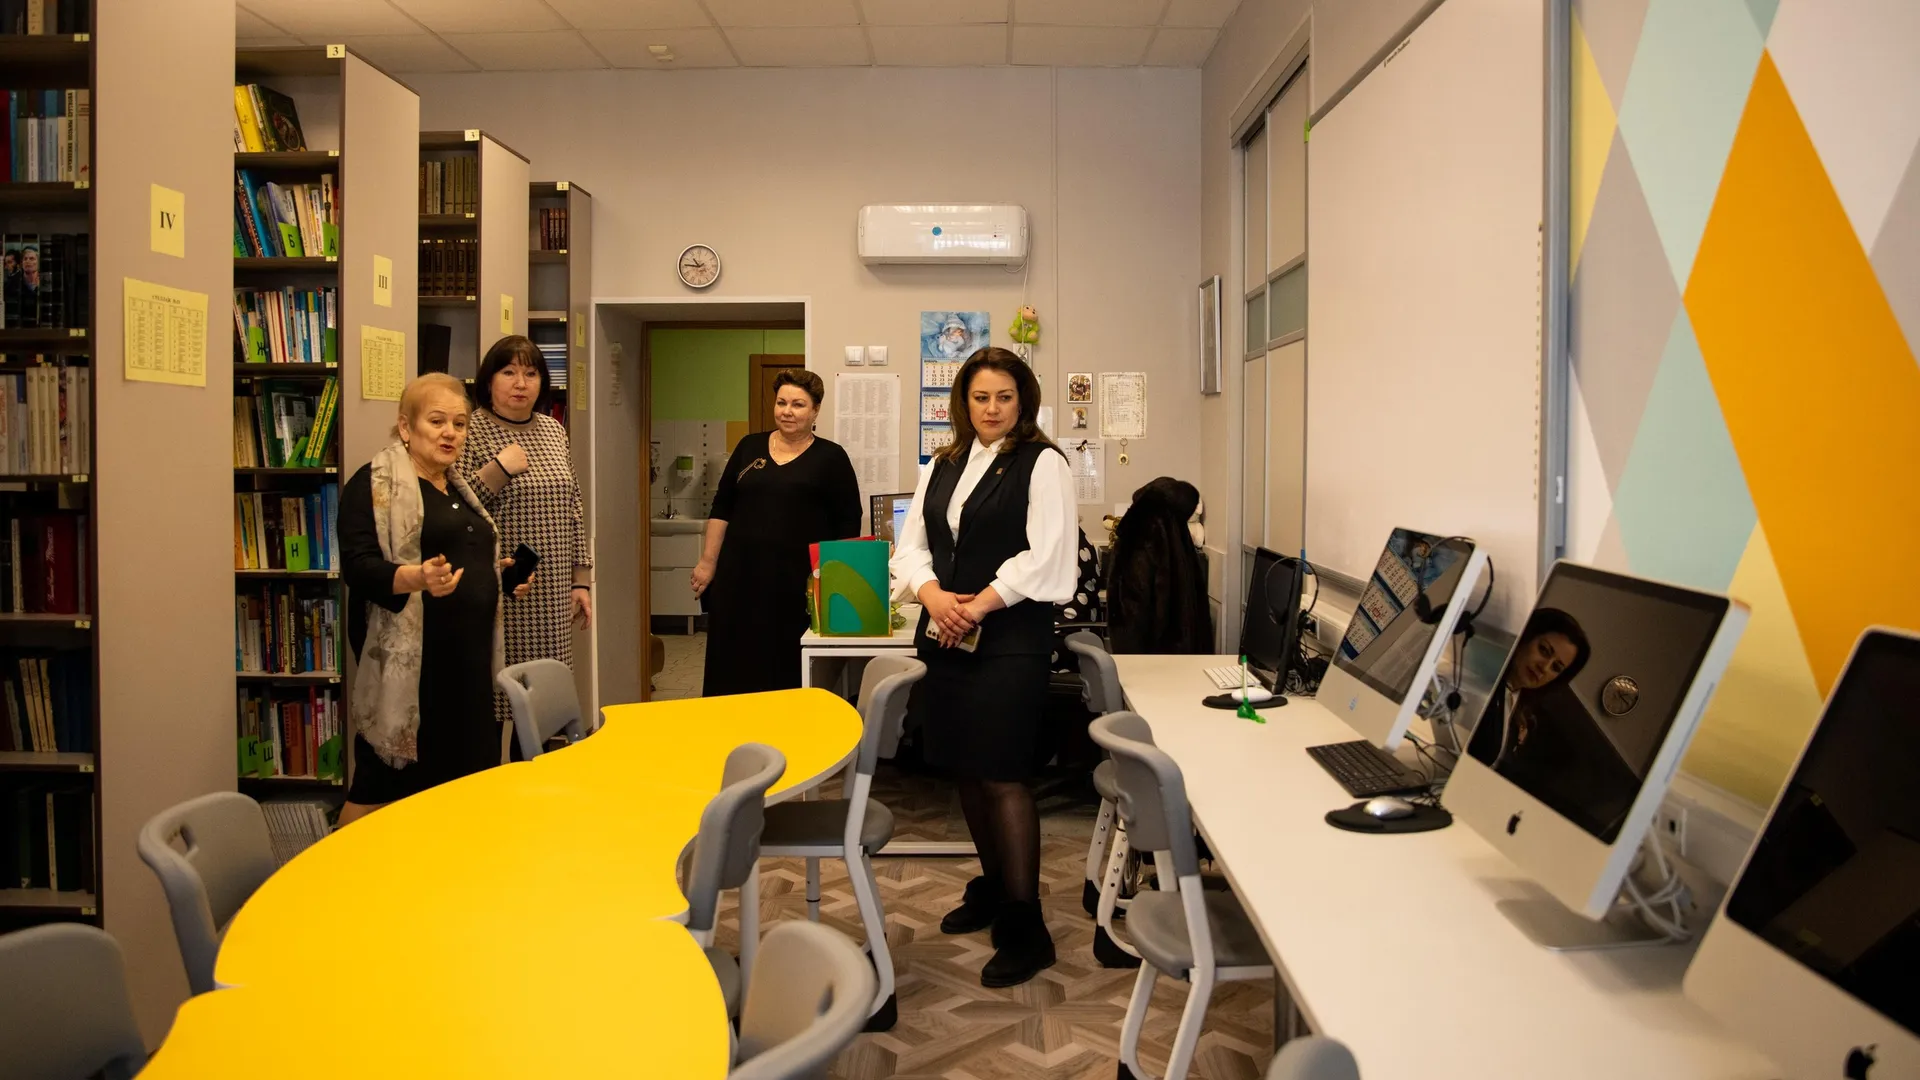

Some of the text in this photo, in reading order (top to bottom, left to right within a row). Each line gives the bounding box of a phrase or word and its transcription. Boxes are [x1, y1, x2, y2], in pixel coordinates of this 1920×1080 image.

[332, 46, 339, 57] 3
[160, 210, 176, 230] IV
[287, 233, 295, 249] Б
[329, 238, 337, 254] А
[378, 274, 388, 290] III
[504, 308, 510, 321] II
[257, 340, 268, 357] Ж
[291, 543, 299, 558] Н
[263, 745, 274, 762] Ш
